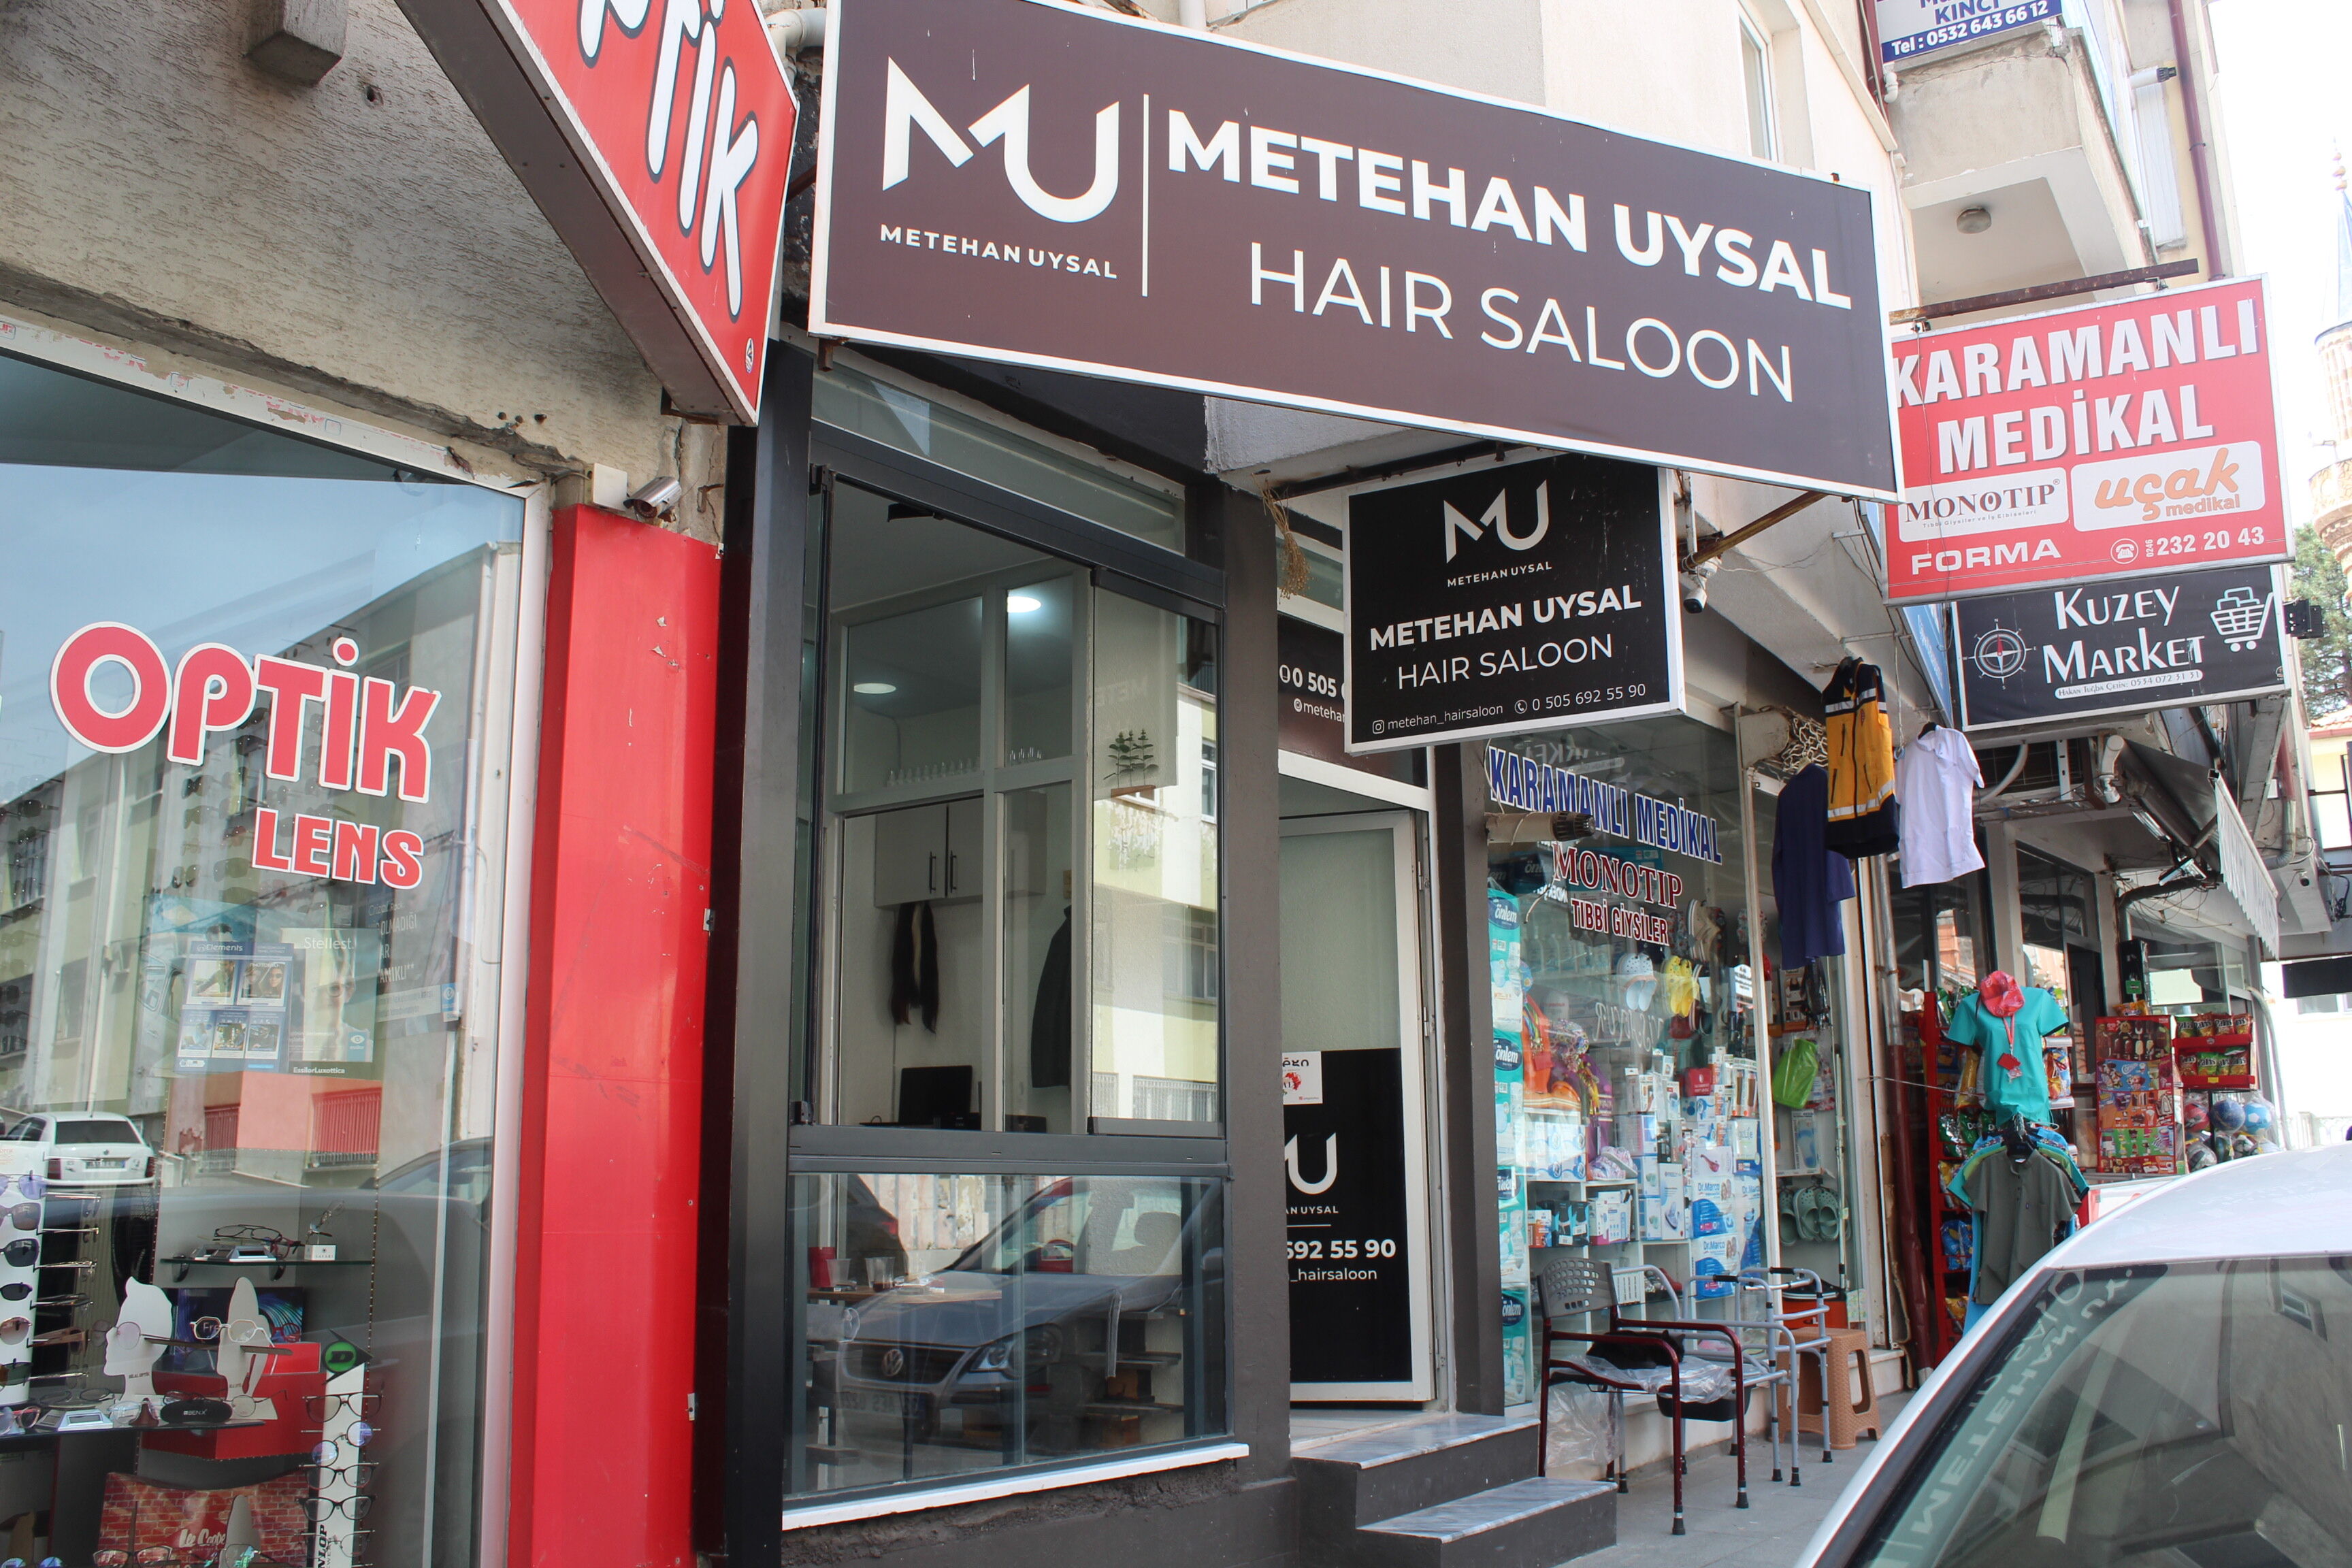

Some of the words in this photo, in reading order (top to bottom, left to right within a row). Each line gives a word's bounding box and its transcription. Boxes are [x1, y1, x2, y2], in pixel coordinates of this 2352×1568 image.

[1927, 23, 1967, 46] 0532
[1970, 15, 2002, 34] 643
[2006, 9, 2027, 25] 66
[2030, 1, 2048, 18] 12
[1169, 109, 1587, 253] METEHAN
[1614, 204, 1852, 310] UYSAL
[880, 224, 1021, 263] METEHAN
[1028, 249, 1117, 280] UYSAL
[1252, 242, 1454, 339] HAIR
[1480, 287, 1793, 403] SALOON
[1893, 298, 2258, 408] KARAMANLI
[1938, 383, 2214, 476] MEDİKAL
[2093, 447, 2240, 521] uçak
[2166, 493, 2241, 517] medikal
[1944, 517, 1976, 526] Giysiler
[1997, 509, 2037, 519] Elbiseleri
[1912, 539, 2062, 576] FORMA
[2145, 538, 2155, 558] 0246
[2156, 534, 2197, 557] 232
[2203, 530, 2230, 551] 20
[2238, 526, 2265, 546] 43
[1447, 569, 1508, 587] METEHAN
[1511, 561, 1552, 576] UYSAL
[1369, 602, 1523, 651] METEHAN
[1533, 585, 1642, 625] UYSAL
[1292, 668, 1303, 687] 0
[1307, 671, 1337, 698] 505
[1398, 657, 1470, 690] HAIR
[1480, 634, 1613, 678] SALOON
[2131, 676, 2153, 687] 0534
[2155, 674, 2172, 685] 072
[51, 621, 442, 804] OPTİK
[1388, 704, 1503, 730] metehan_hairsaloon
[1532, 698, 1541, 712] 0
[1546, 692, 1571, 710] 505
[1575, 689, 1601, 706] 692
[1607, 685, 1624, 702] 55
[1628, 683, 1646, 698] 90
[1488, 745, 1630, 840] KARAMANLI
[1635, 793, 1722, 866] MEDİKAL
[252, 806, 424, 889] LENS
[1552, 841, 1682, 910] MONOTIP
[1494, 903, 1518, 924] önlem
[1571, 895, 1609, 934] TIBBİ
[1612, 902, 1670, 946] GİYSİLER
[206, 943, 243, 951] Elements
[1494, 1039, 1519, 1064] önlem
[1301, 1205, 1339, 1215] UYSAL
[1330, 1239, 1358, 1259] 55
[1365, 1239, 1396, 1258] 90
[179, 1529, 197, 1548] Lee
